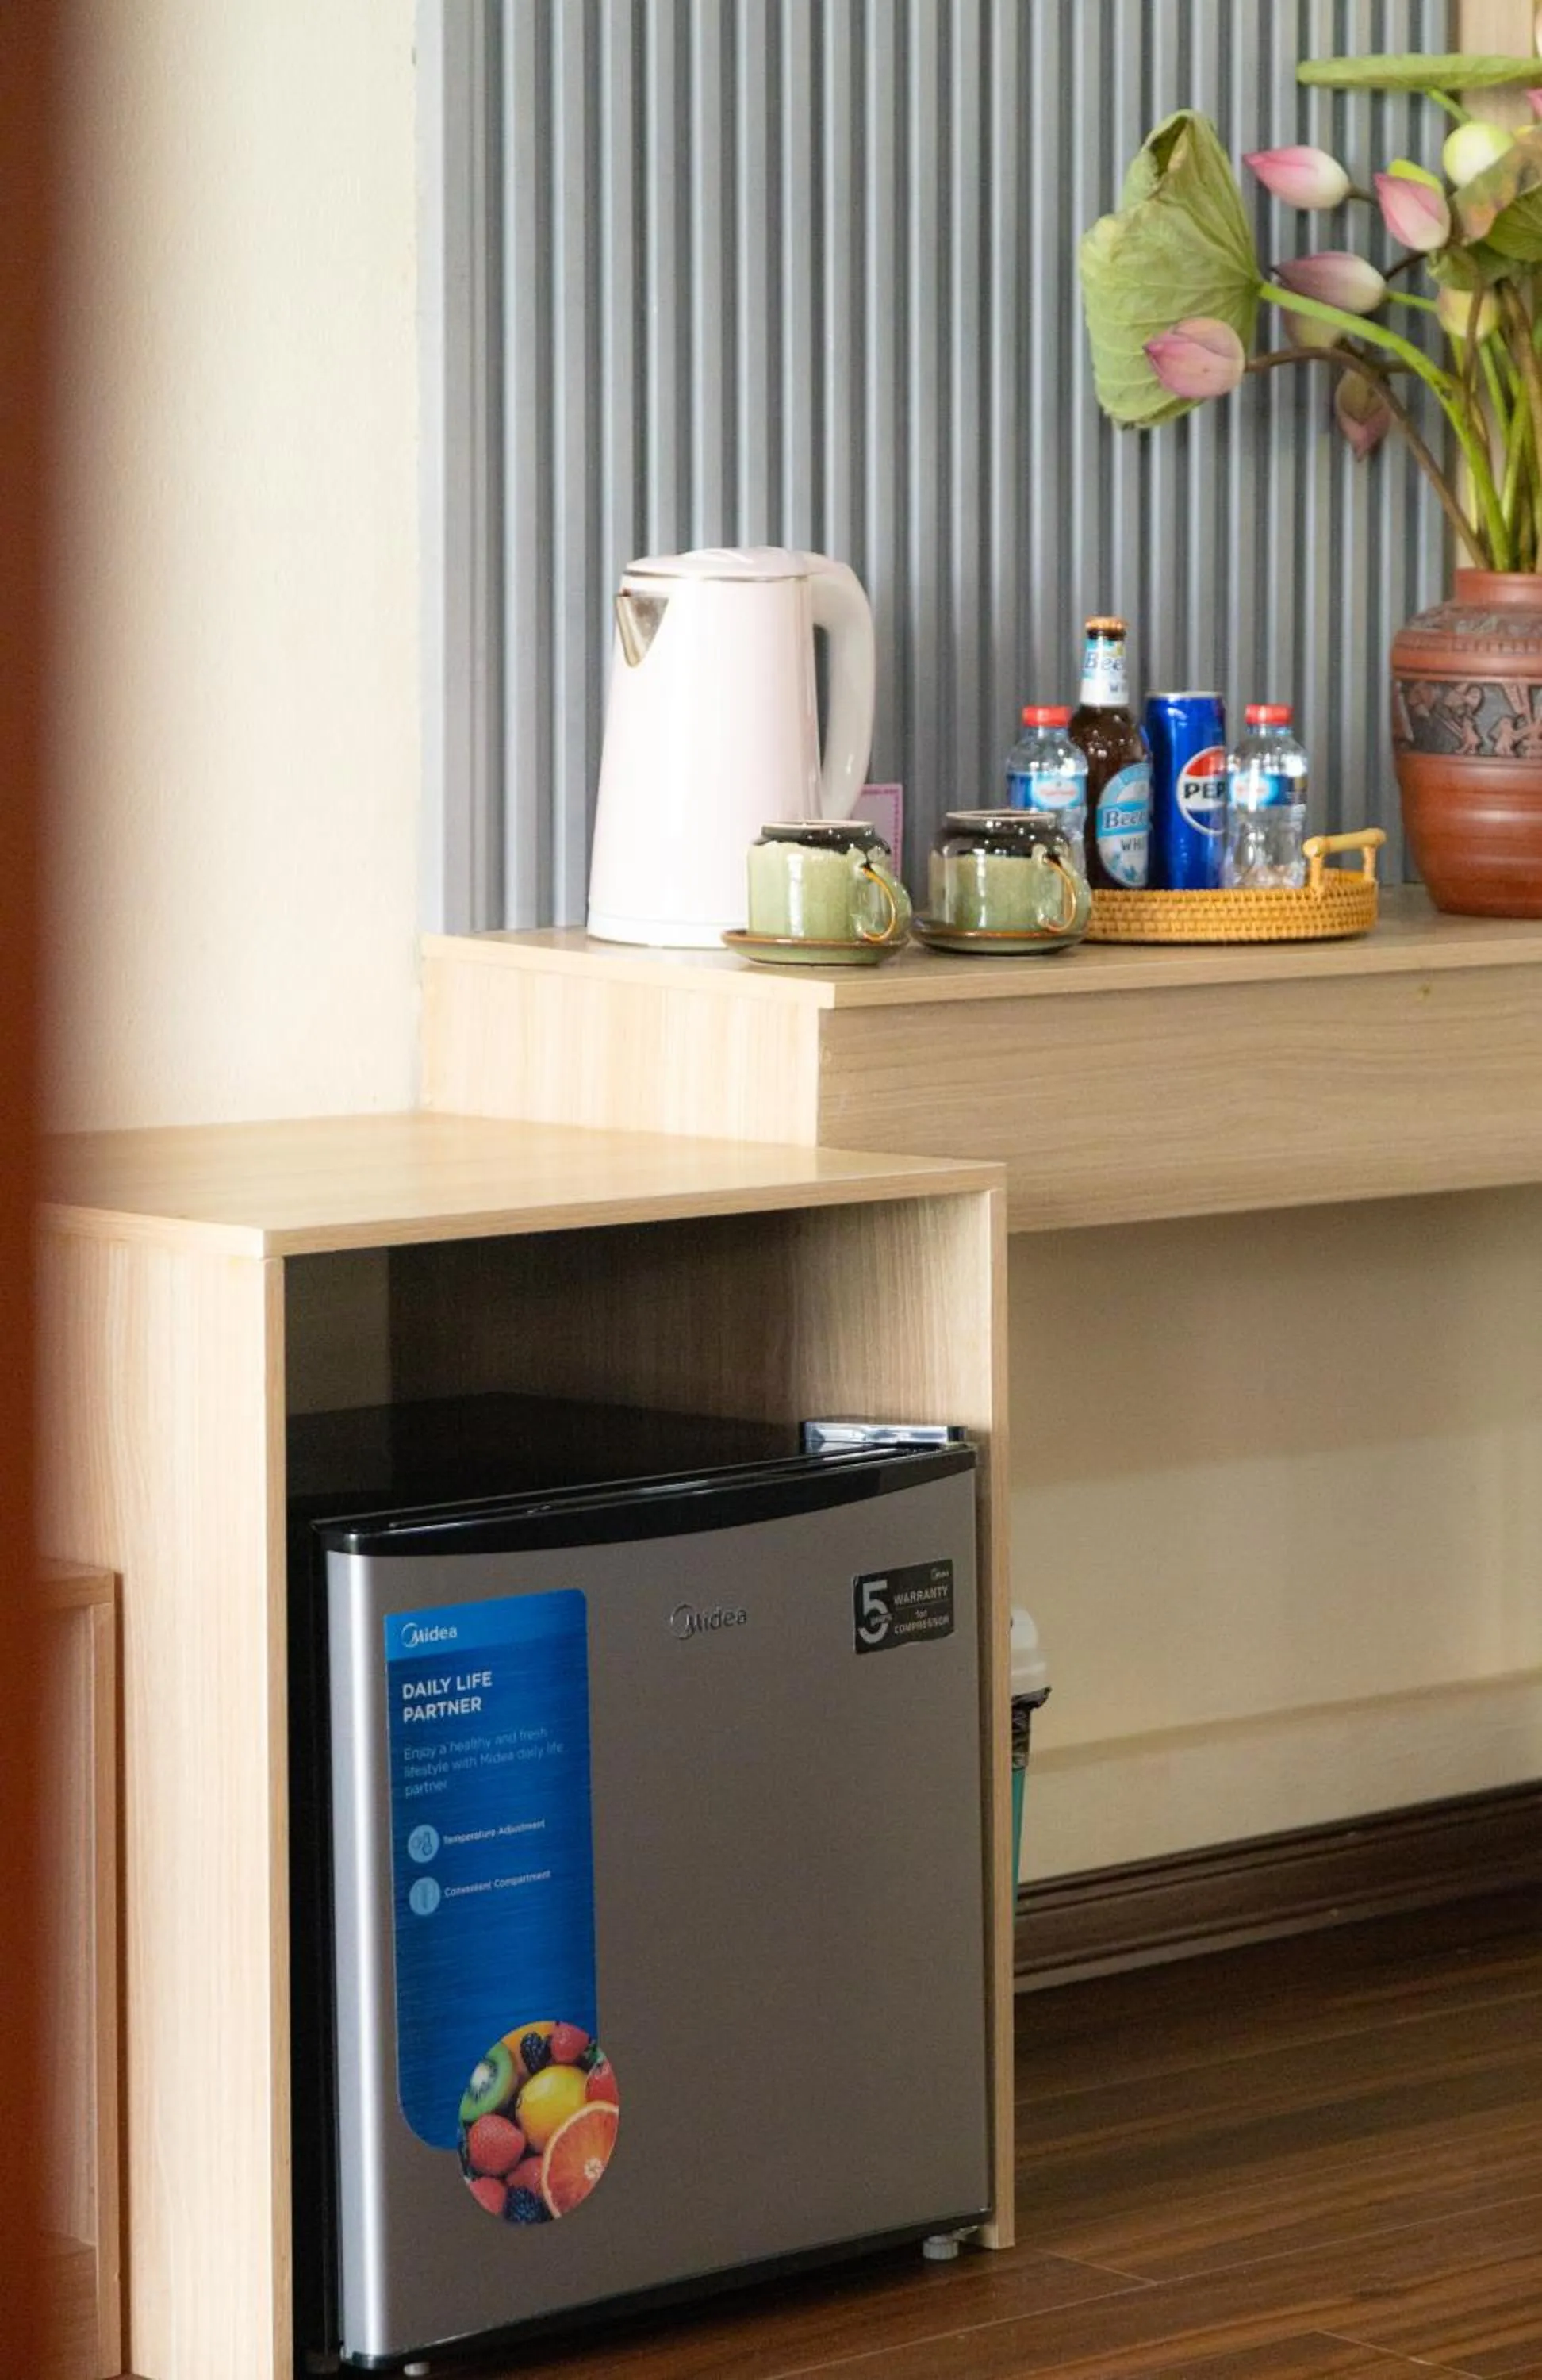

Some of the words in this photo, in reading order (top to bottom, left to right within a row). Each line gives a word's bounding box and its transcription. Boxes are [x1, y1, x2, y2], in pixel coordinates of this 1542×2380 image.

[893, 1585, 949, 1606] WARRANTY
[670, 1604, 747, 1640] Midea
[858, 1580, 888, 1644] 5
[894, 1615, 949, 1634] COMPRESSOR
[401, 1622, 458, 1648] Midea
[402, 1677, 452, 1699] DAILY
[456, 1671, 493, 1691] LIFE
[402, 1696, 482, 1722] PARTNER
[404, 1747, 436, 1761] Enjoy
[439, 1745, 447, 1755] a
[449, 1737, 491, 1752] healthy
[495, 1732, 516, 1745] and
[520, 1727, 548, 1740] fresh
[404, 1760, 450, 1779] lifestyle
[451, 1756, 477, 1770] with
[480, 1751, 514, 1765] Midea
[516, 1746, 544, 1761] daily
[547, 1741, 564, 1755] life
[405, 1779, 447, 1800] partner
[443, 1829, 495, 1844] Temperature
[499, 1819, 545, 1835] Adjustment
[444, 1880, 491, 1898] Convenient
[494, 1870, 551, 1888] Compartment
